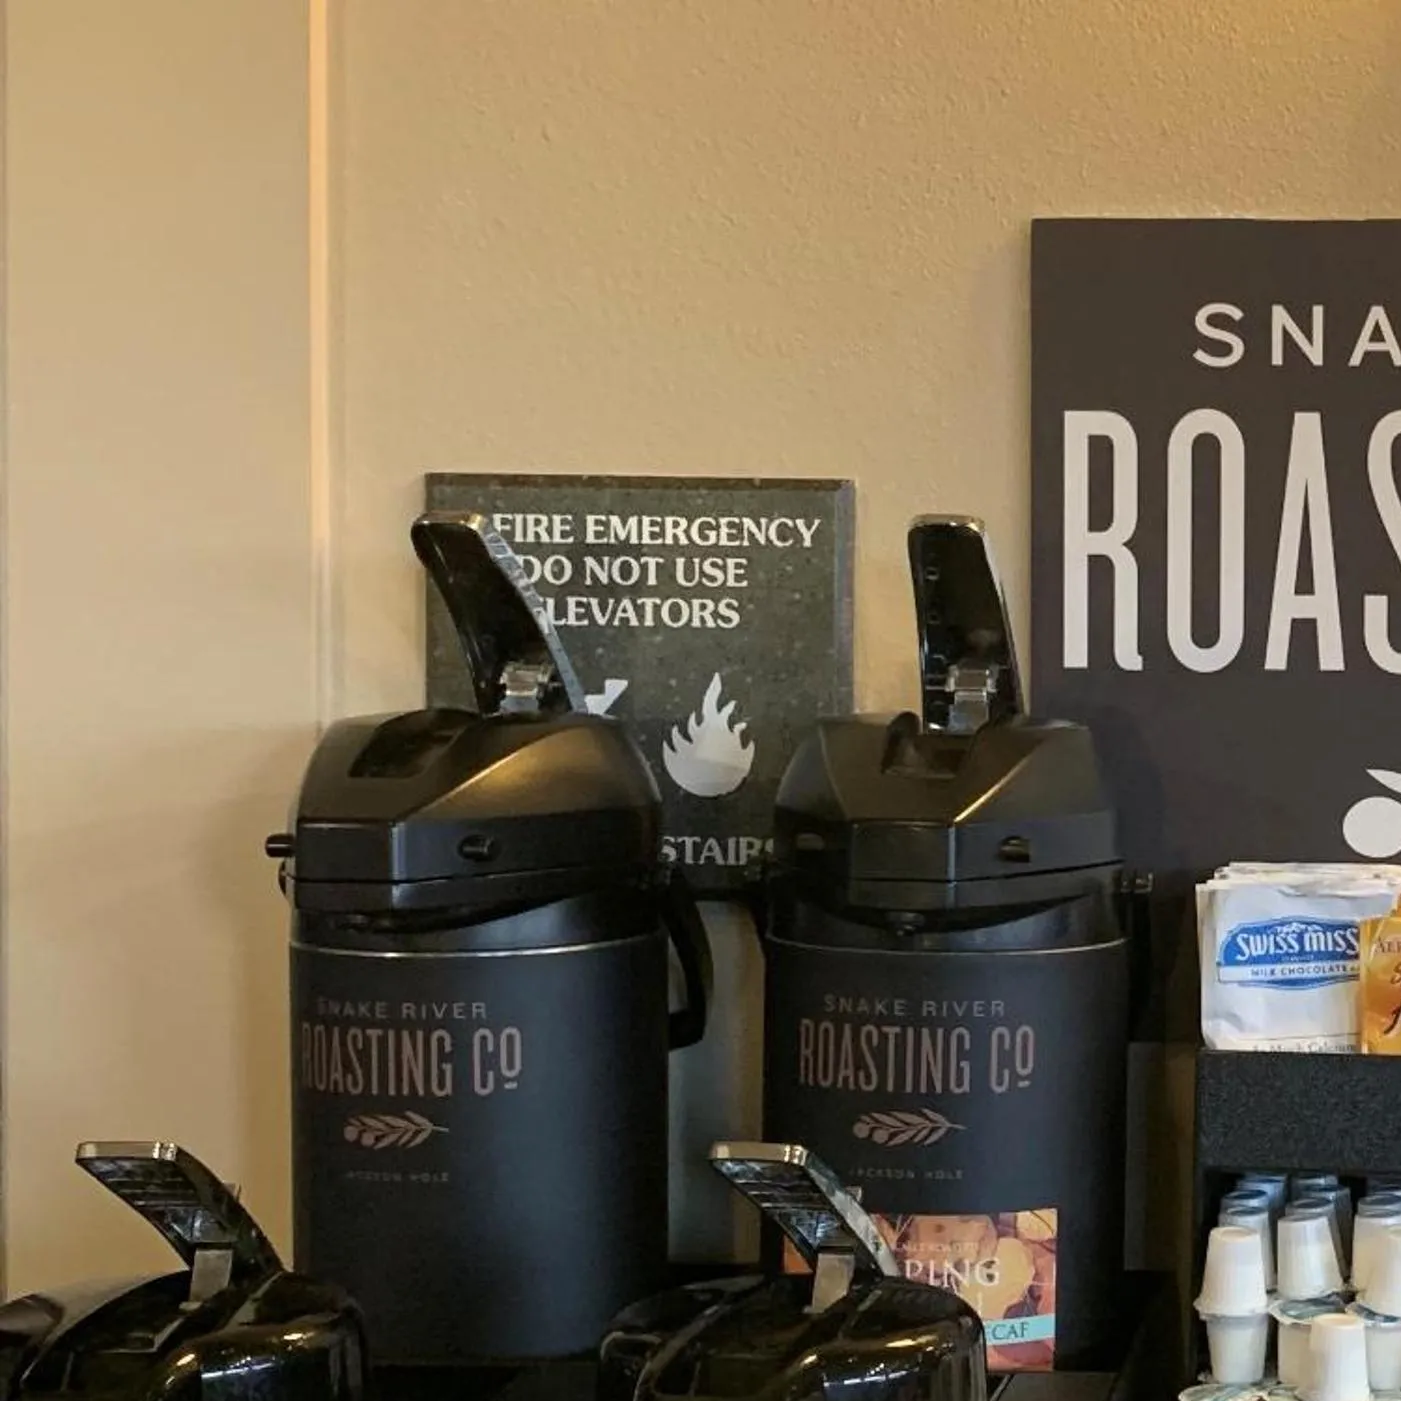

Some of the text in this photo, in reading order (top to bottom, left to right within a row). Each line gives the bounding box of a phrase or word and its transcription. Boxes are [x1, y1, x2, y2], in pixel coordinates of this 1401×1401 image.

[493, 513, 821, 548] FIRE EMERGENCY
[519, 556, 749, 588] DO NOT USE
[541, 597, 741, 629] LEVATORS
[1235, 927, 1359, 961] SWISS MISS
[1281, 965, 1348, 977] CHOCOLATE
[402, 1001, 487, 1021] RIVER
[824, 995, 1006, 1017] SNAKE RIVER
[301, 1022, 453, 1097] ROASTING
[801, 1018, 970, 1094] ROASTING
